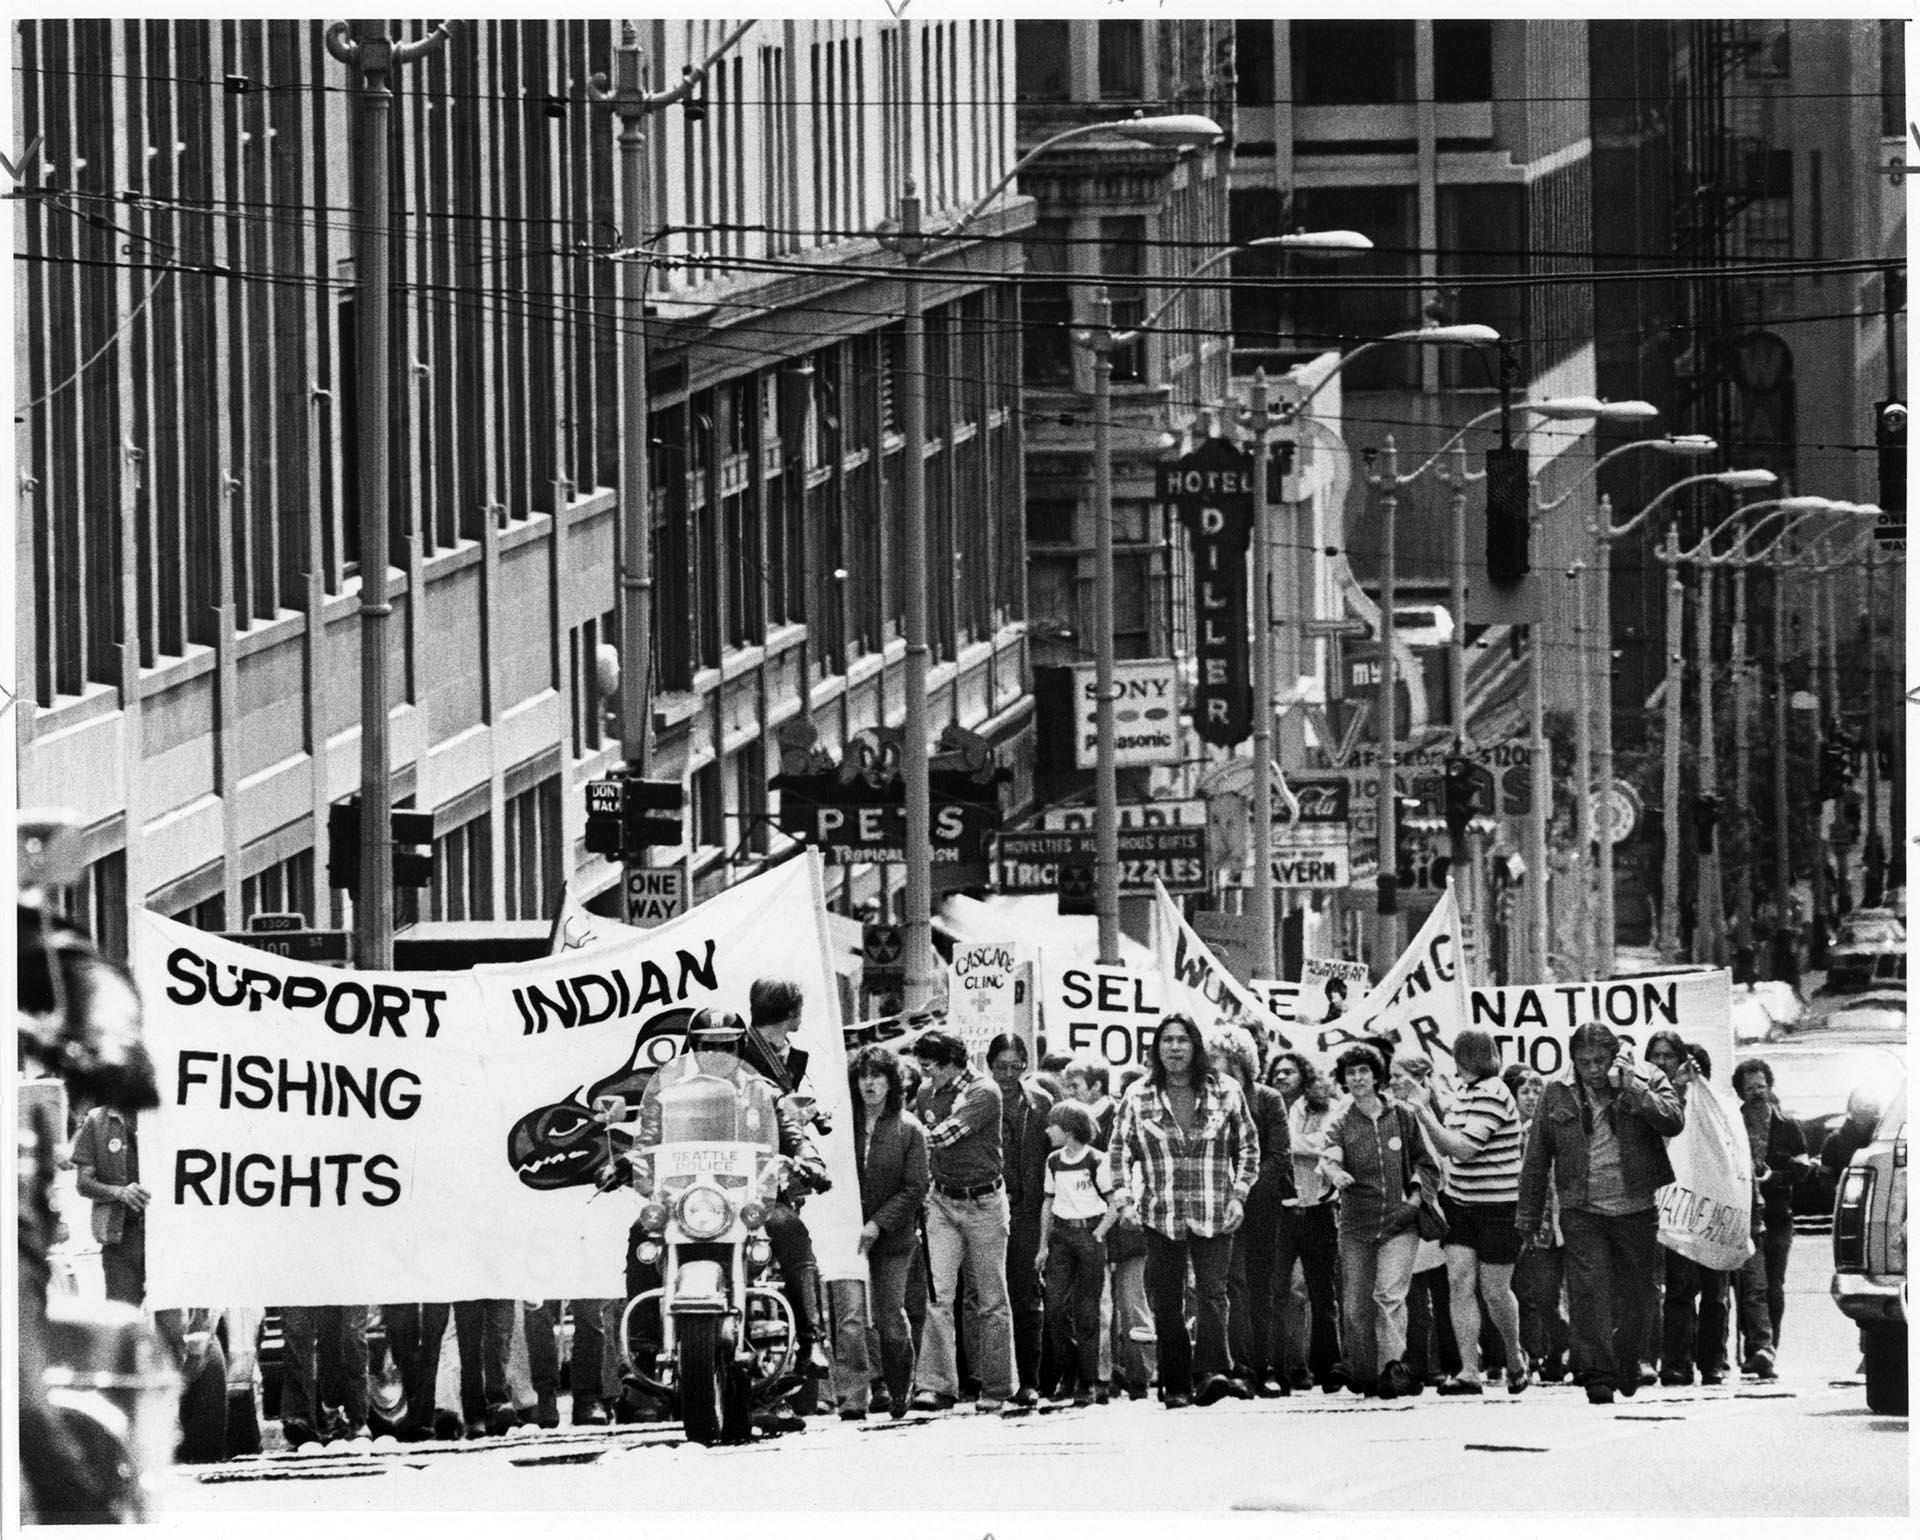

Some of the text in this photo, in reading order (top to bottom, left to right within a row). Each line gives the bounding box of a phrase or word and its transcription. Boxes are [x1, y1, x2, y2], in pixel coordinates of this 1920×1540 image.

[1167, 470, 1252, 494] HOTEL
[1201, 507, 1230, 725] DILLER
[817, 805, 965, 842] PES
[629, 873, 677, 895] ONE
[629, 900, 677, 919] WAY
[956, 947, 1015, 976] CASCADE
[165, 939, 719, 1038] SUPPORT INDIAN
[176, 1049, 422, 1121] FISHING
[671, 1150, 738, 1161] SEATTLE
[675, 1161, 734, 1172] POLICE
[173, 1147, 402, 1208] RIGHTS
